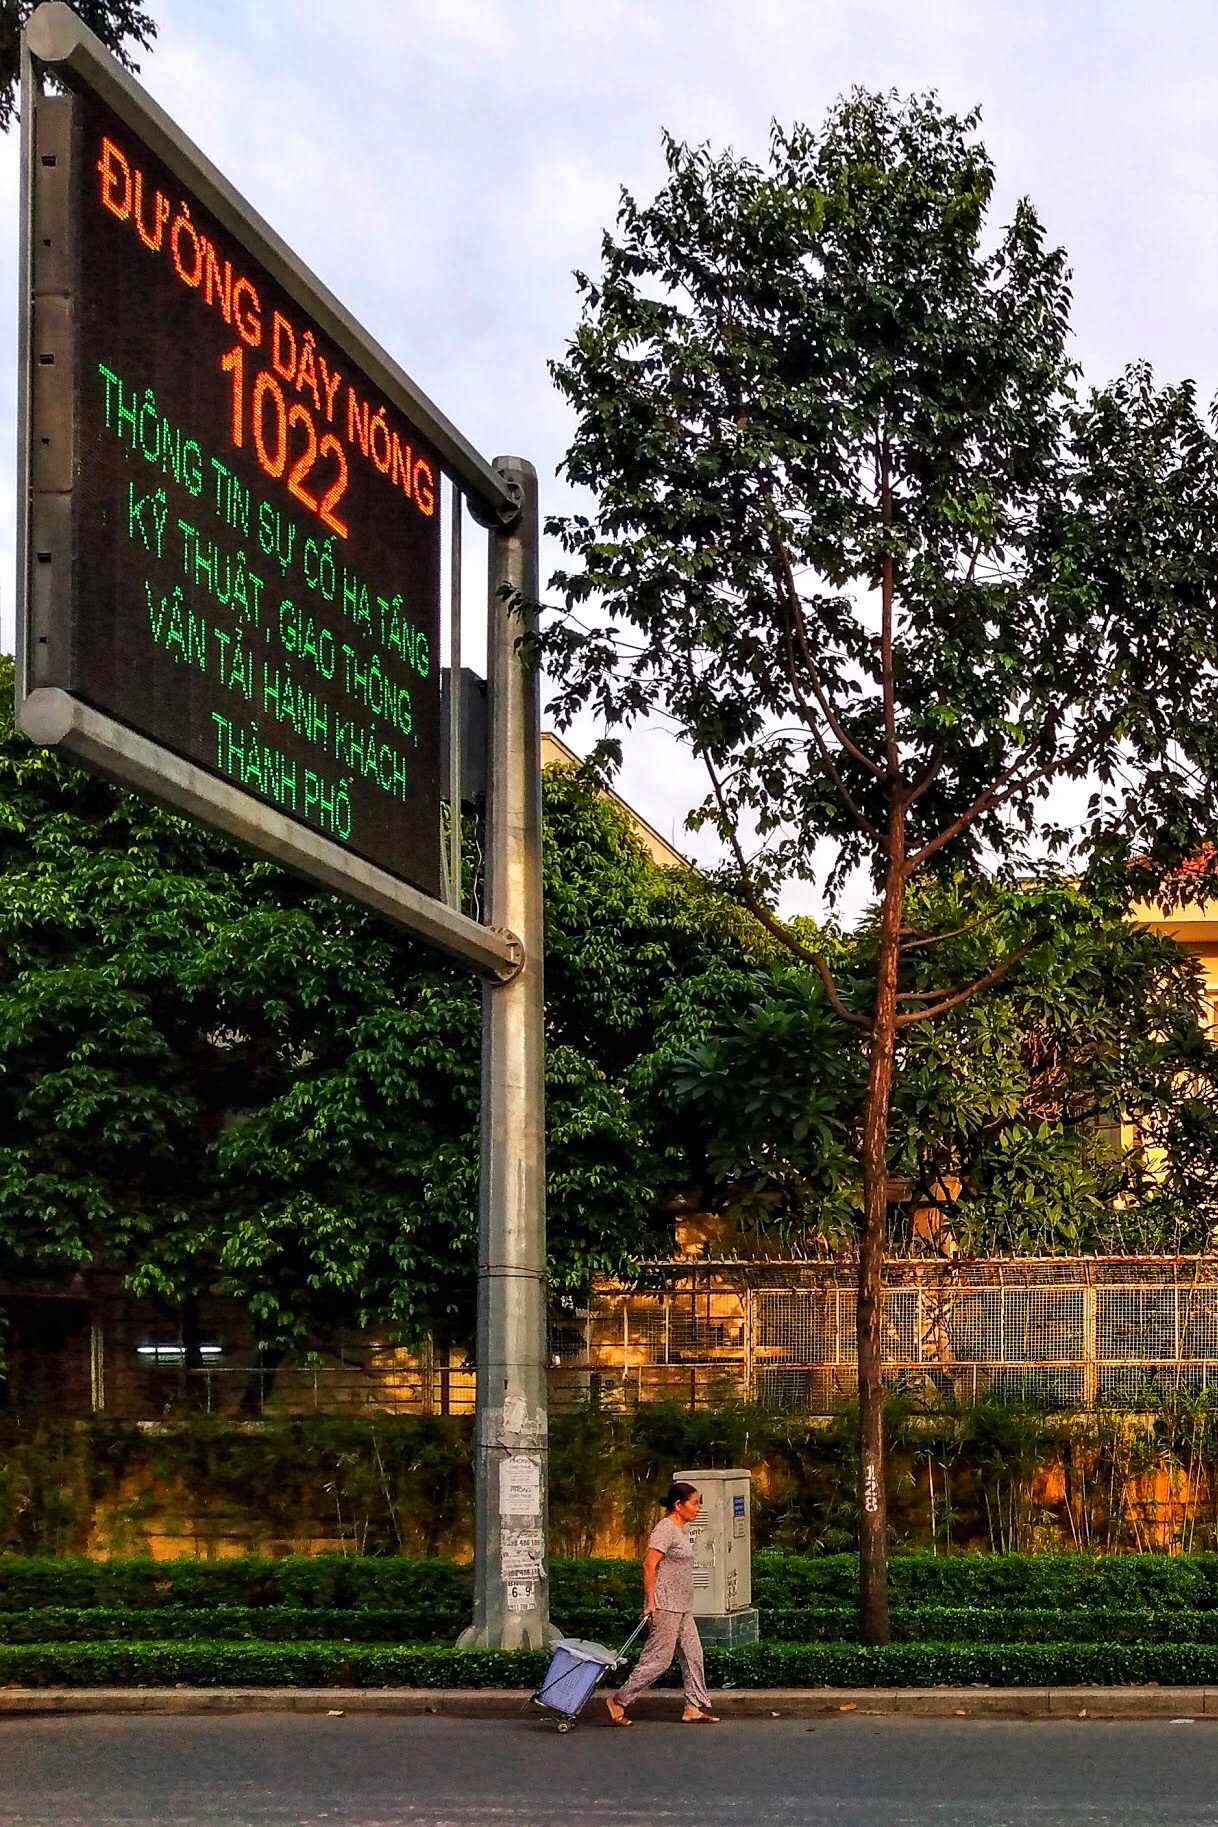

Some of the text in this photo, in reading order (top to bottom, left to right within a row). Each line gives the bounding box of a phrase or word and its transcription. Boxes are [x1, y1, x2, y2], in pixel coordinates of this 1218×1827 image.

[97, 135, 434, 517] ĐƯỜNG DÂY NÓNG
[98, 363, 430, 678] THÔNG TIN SỰ CỐ HẠ TẦNG
[220, 345, 348, 539] 1022
[144, 580, 407, 802] VẬN TẢI HÀNH KHÁCH
[279, 599, 336, 680] GIAO
[211, 711, 354, 841] THÀNH PHỐ
[864, 1464, 878, 1512] 128
